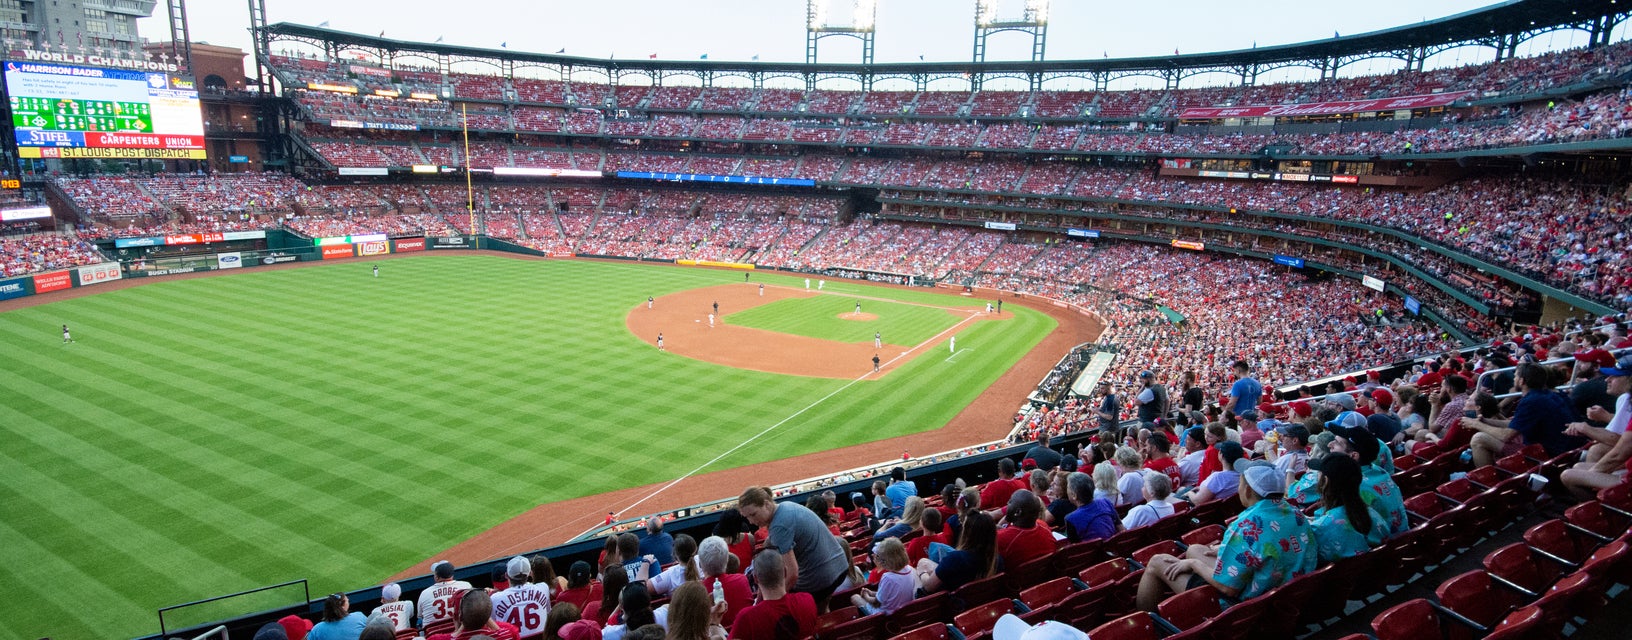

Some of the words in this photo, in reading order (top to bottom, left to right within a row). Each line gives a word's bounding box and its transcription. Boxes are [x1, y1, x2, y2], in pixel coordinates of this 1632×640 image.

[23, 49, 84, 63] WORLD
[88, 56, 178, 72] CHAMPIONS
[22, 64, 71, 75] HARRISON
[72, 67, 103, 77] BADER
[30, 130, 72, 142] STIFEL
[100, 135, 160, 146] CARPENTERS
[165, 137, 192, 146] UNION
[64, 147, 80, 157] ST.
[81, 147, 112, 158] LOUIS
[115, 148, 191, 158] POST-DISPATCH
[650, 172, 696, 180] TIME
[380, 604, 404, 614] MUSIAL
[506, 602, 541, 633] 46
